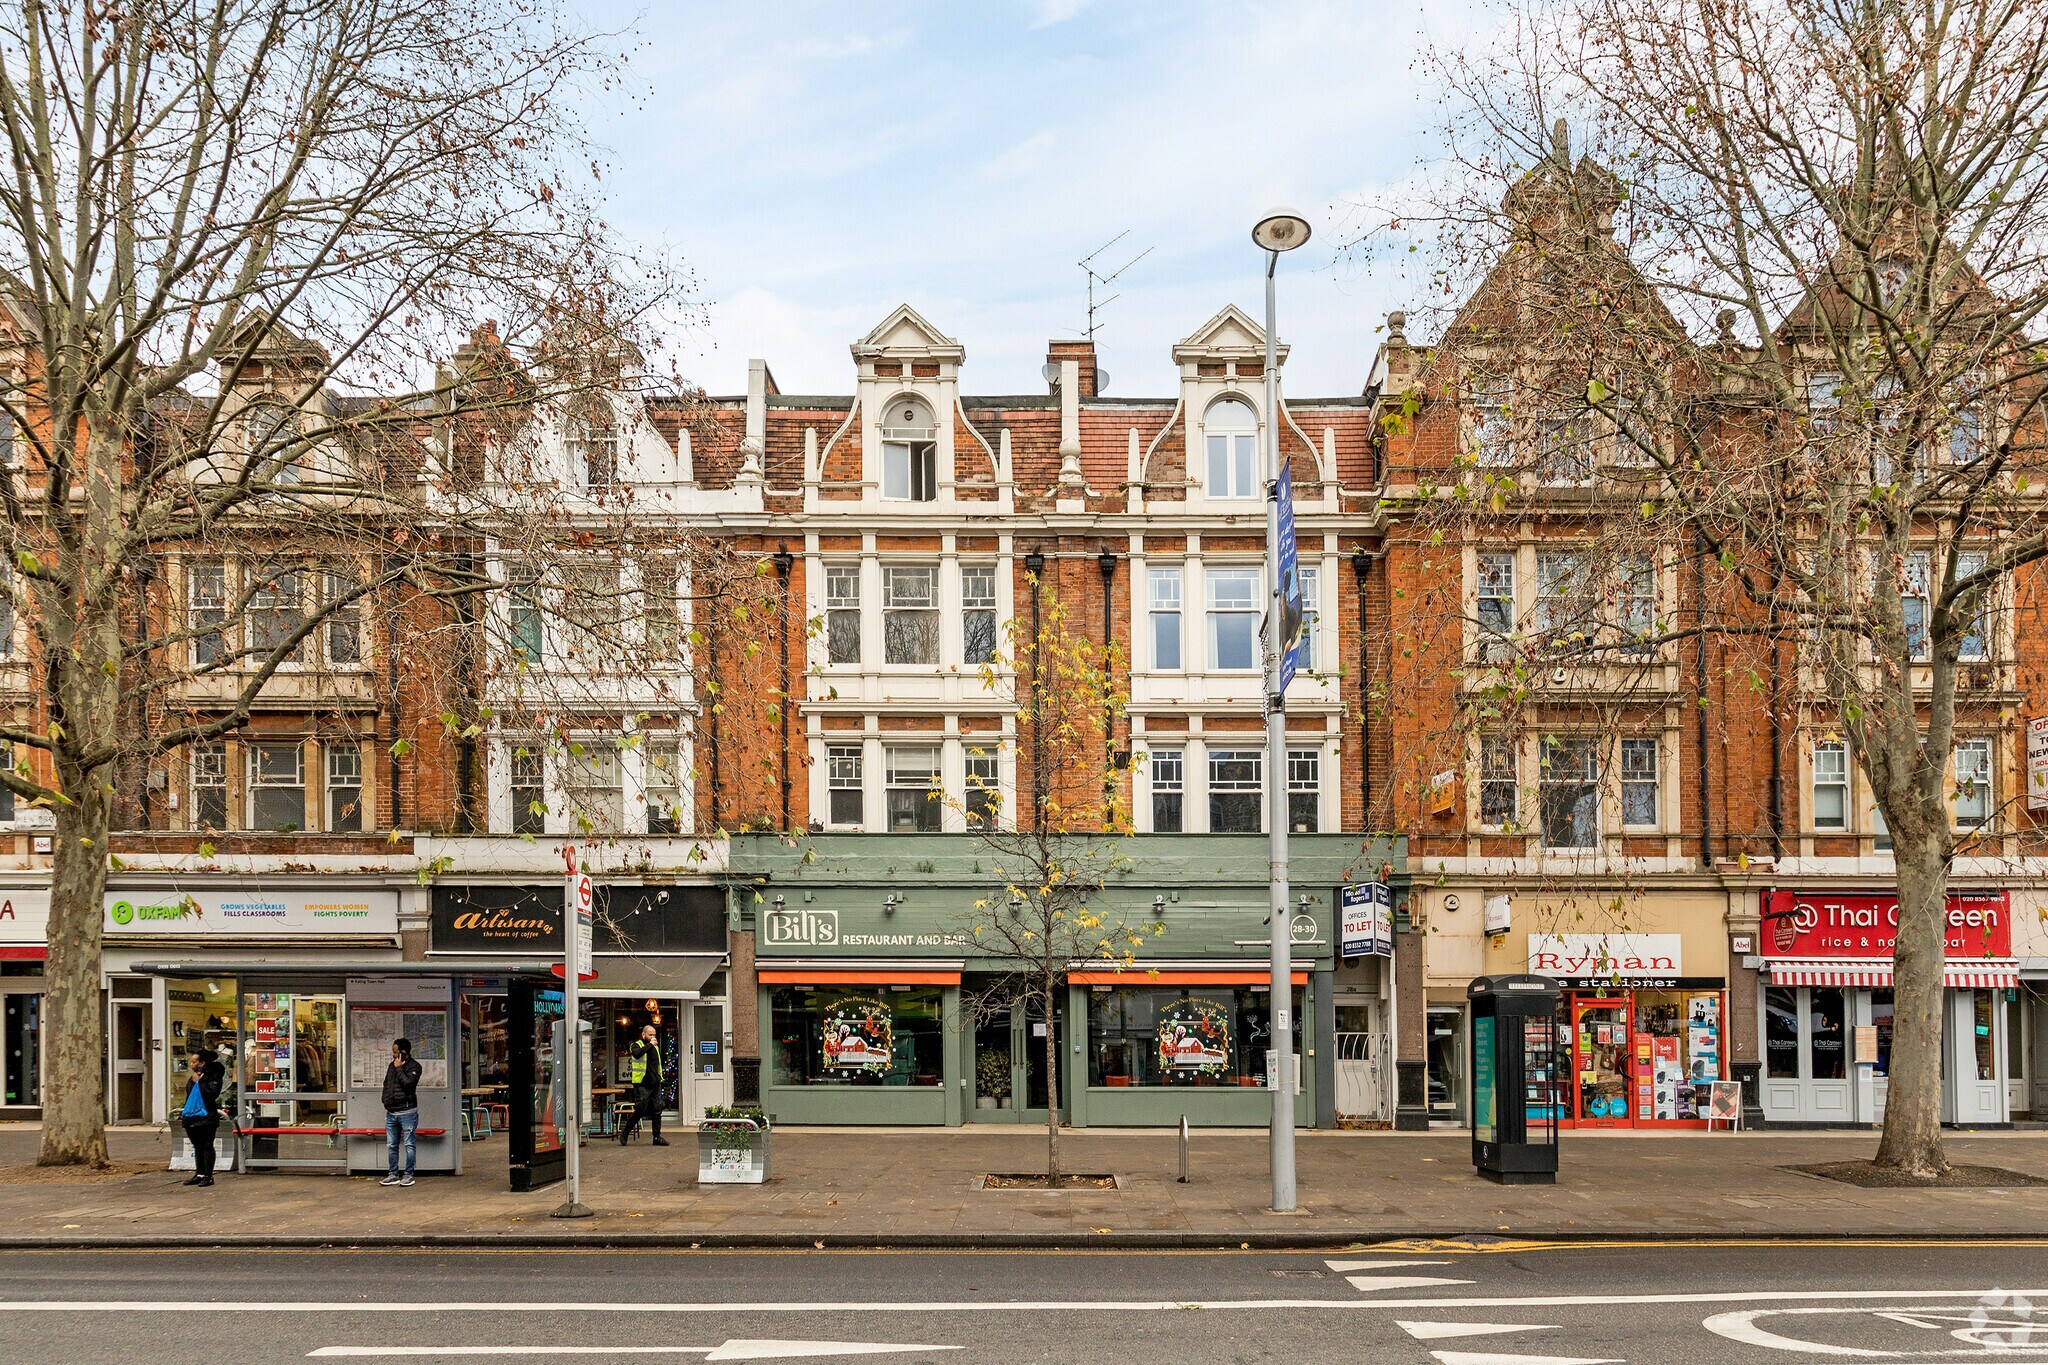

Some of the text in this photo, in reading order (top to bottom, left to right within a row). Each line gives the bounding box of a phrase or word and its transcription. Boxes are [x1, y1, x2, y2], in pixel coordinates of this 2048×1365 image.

[1350, 895, 1365, 903] Rogers
[137, 905, 181, 920] OXFAM
[1348, 911, 1367, 920] OFFICES
[1824, 904, 1878, 926] Thai
[771, 910, 834, 945] Bill's
[1293, 925, 1315, 933] 28-30
[1344, 920, 1372, 933] TO LET
[1377, 920, 1383, 931] TO
[843, 935, 966, 946] RESTAURANT AND BAR
[1821, 937, 1851, 946] rice
[1860, 937, 1869, 946] &
[1535, 953, 1675, 973] Ryman
[824, 1000, 844, 1011] There's
[867, 996, 878, 1005] Like
[1161, 1000, 1180, 1012] There's
